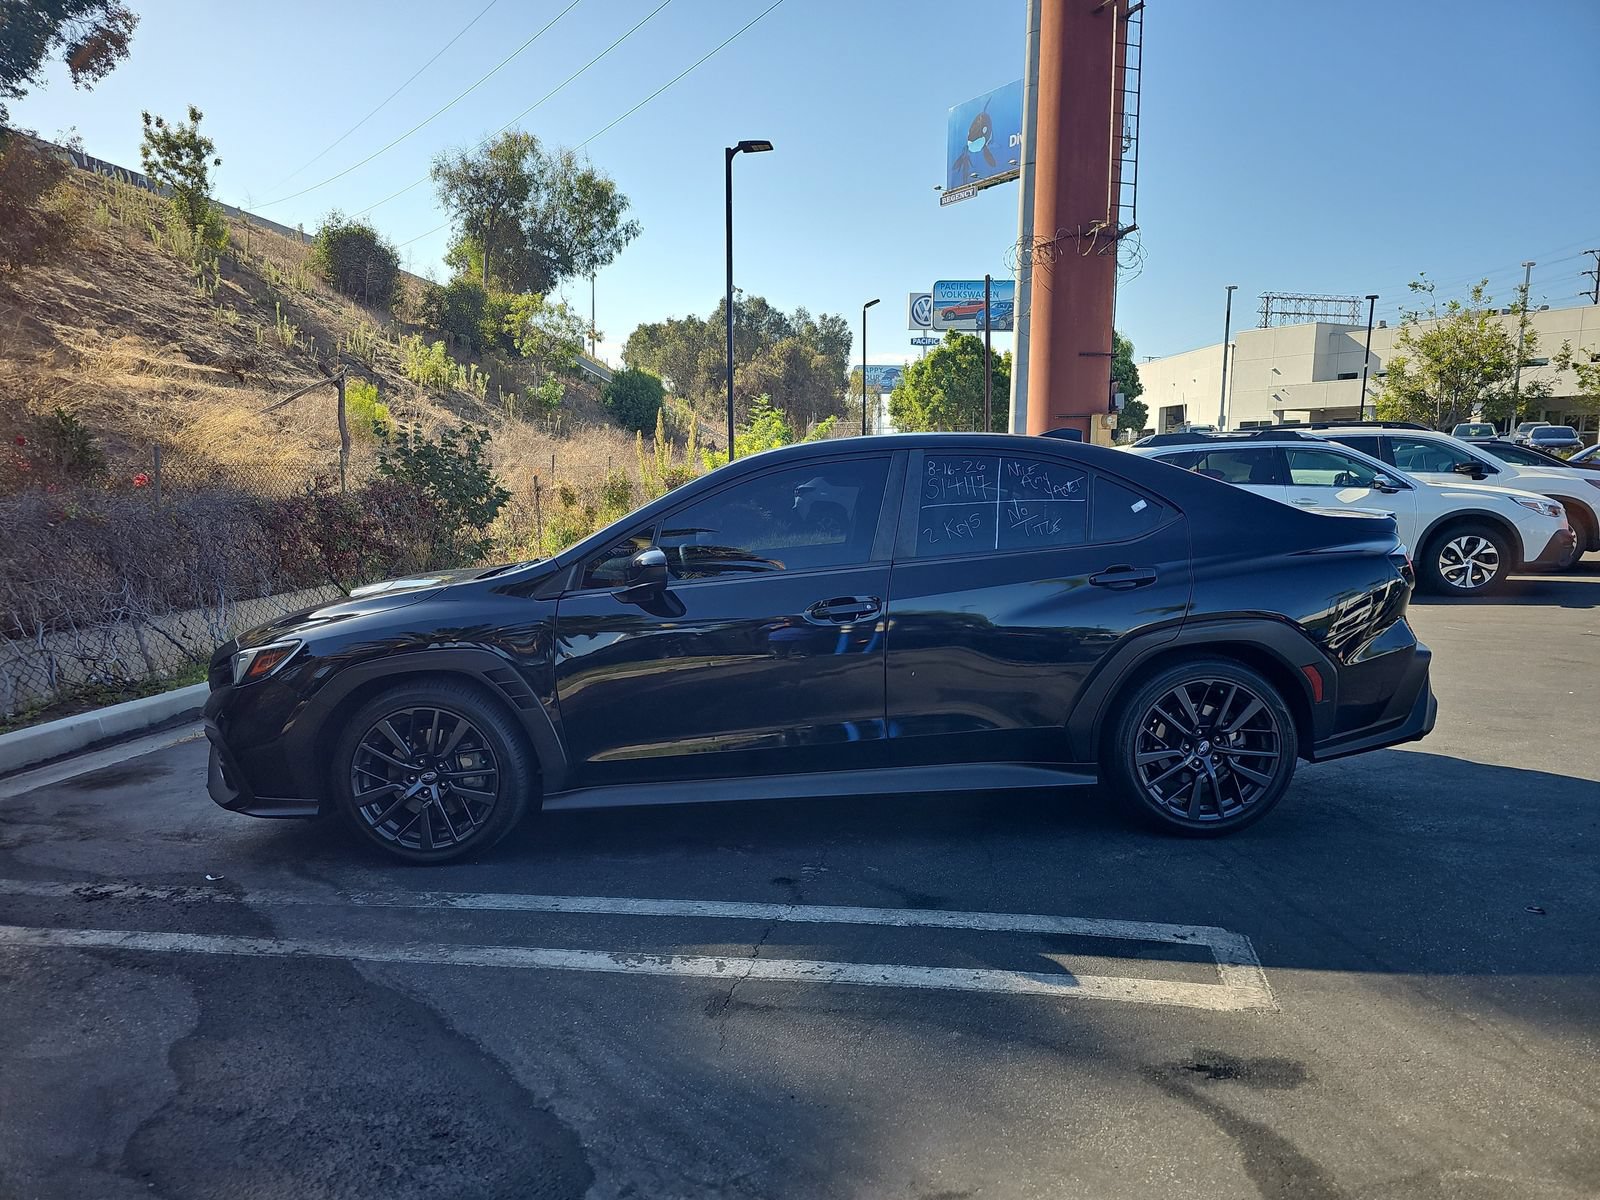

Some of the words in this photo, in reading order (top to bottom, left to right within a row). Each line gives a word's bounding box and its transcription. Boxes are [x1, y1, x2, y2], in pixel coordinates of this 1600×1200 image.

[941, 188, 975, 205] REGENCY
[941, 282, 972, 290] PACIFIC
[912, 337, 939, 345] PACIFIC
[927, 460, 986, 476] 8-16-26
[922, 527, 939, 543] 2
